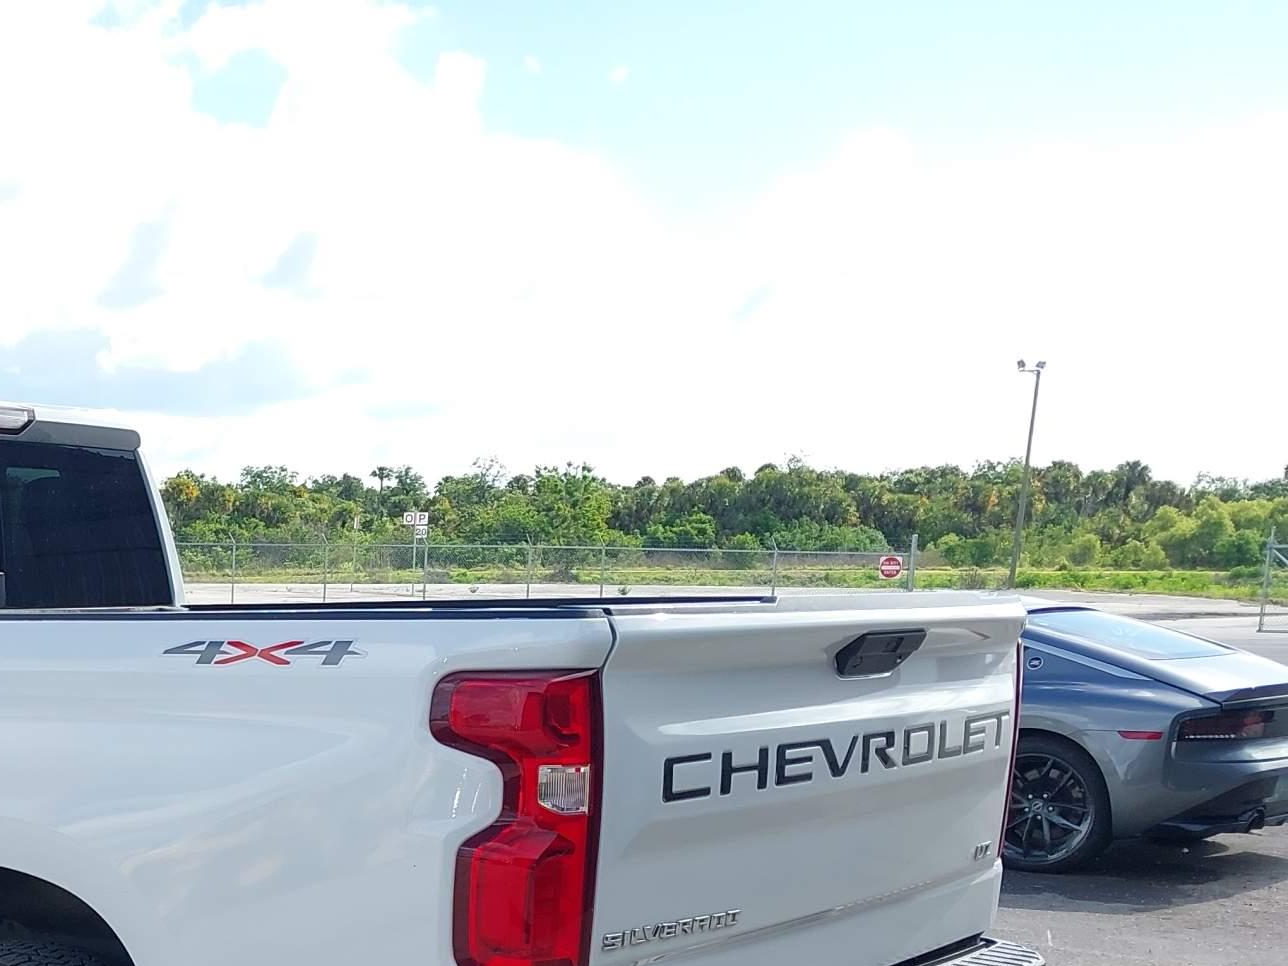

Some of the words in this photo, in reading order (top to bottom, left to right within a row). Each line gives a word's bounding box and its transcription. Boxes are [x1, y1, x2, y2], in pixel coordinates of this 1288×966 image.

[405, 513, 414, 523] O
[418, 513, 426, 523] P
[415, 528, 427, 536] 20
[661, 709, 1010, 804] CHEVROLET
